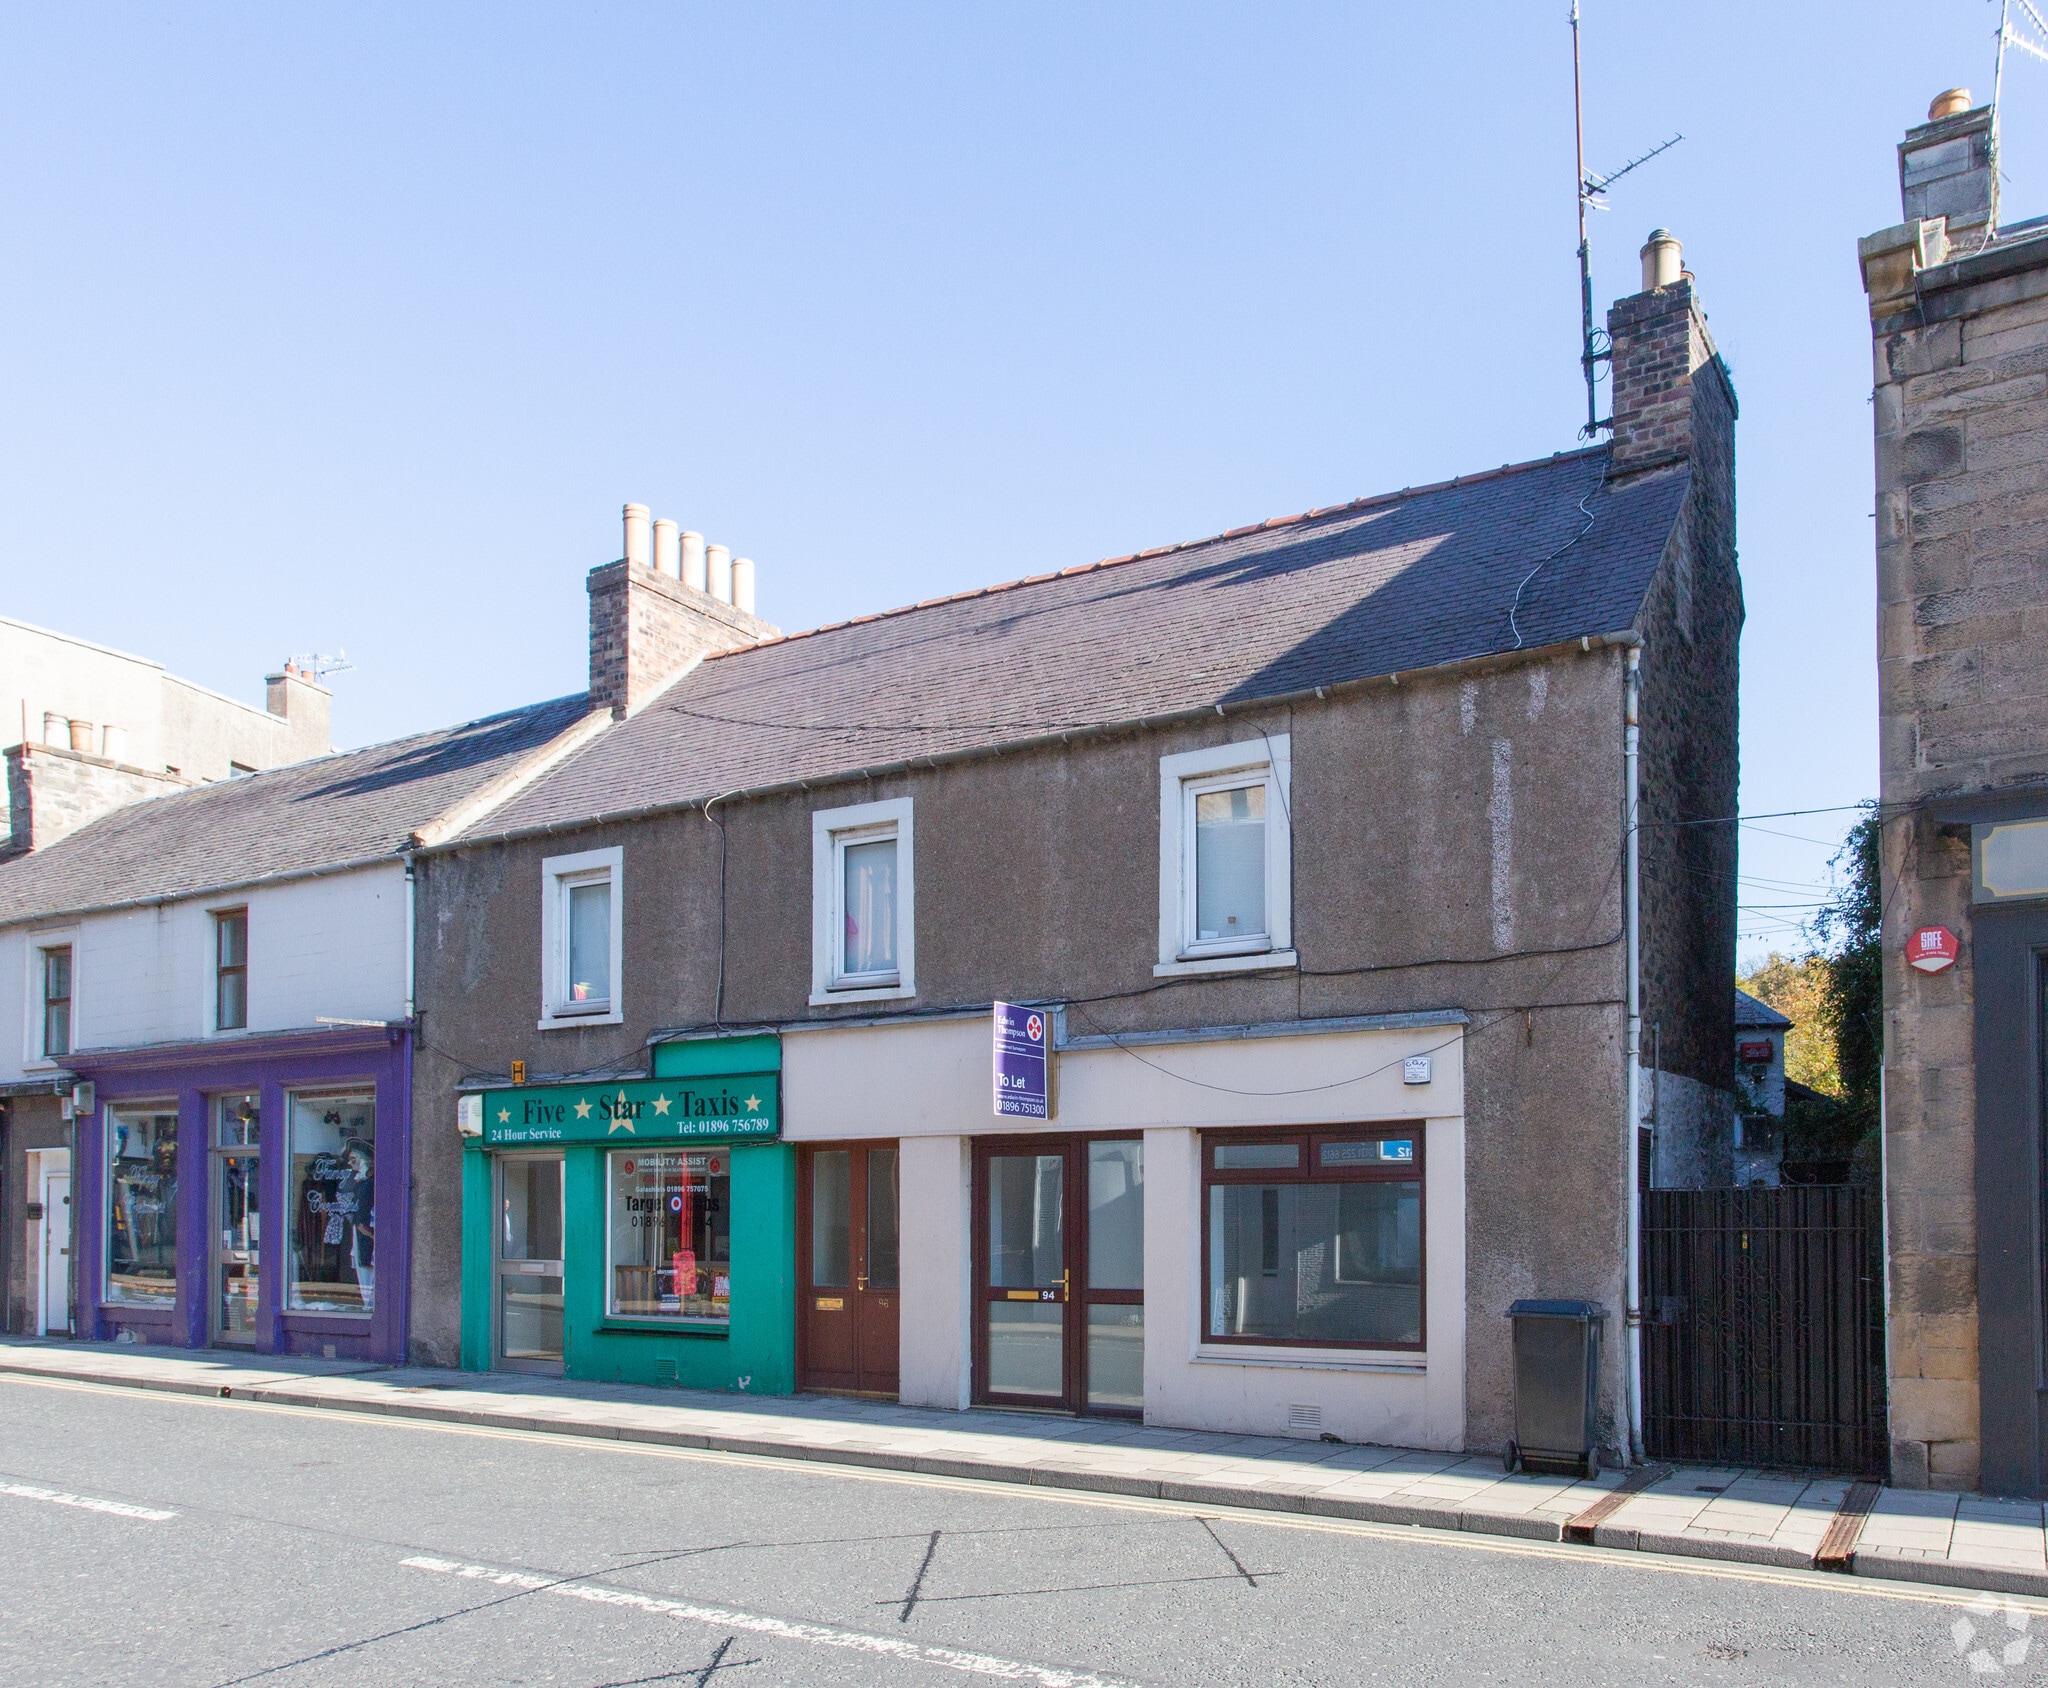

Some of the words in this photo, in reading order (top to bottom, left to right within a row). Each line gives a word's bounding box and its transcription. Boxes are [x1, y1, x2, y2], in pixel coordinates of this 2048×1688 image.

[1921, 931, 1943, 948] SAFE
[997, 1015, 1015, 1027] Edwin
[997, 1025, 1026, 1039] Thompson
[512, 1062, 524, 1081] H
[997, 1073, 1009, 1087] To
[1011, 1075, 1026, 1089] Let
[523, 1098, 566, 1125] Five
[599, 1094, 646, 1121] Star
[678, 1089, 739, 1118] Taxis
[997, 1100, 1020, 1112] 01896
[1020, 1103, 1045, 1115] 751300
[491, 1129, 502, 1141] 24
[504, 1128, 527, 1141] Hour
[529, 1126, 562, 1139] Service
[677, 1121, 696, 1134] Tel:
[698, 1120, 729, 1133] 01896
[732, 1118, 769, 1132] 756789
[637, 1157, 675, 1167] MOBILITY
[677, 1157, 707, 1166] ASSIST
[1042, 1291, 1055, 1300] 94
